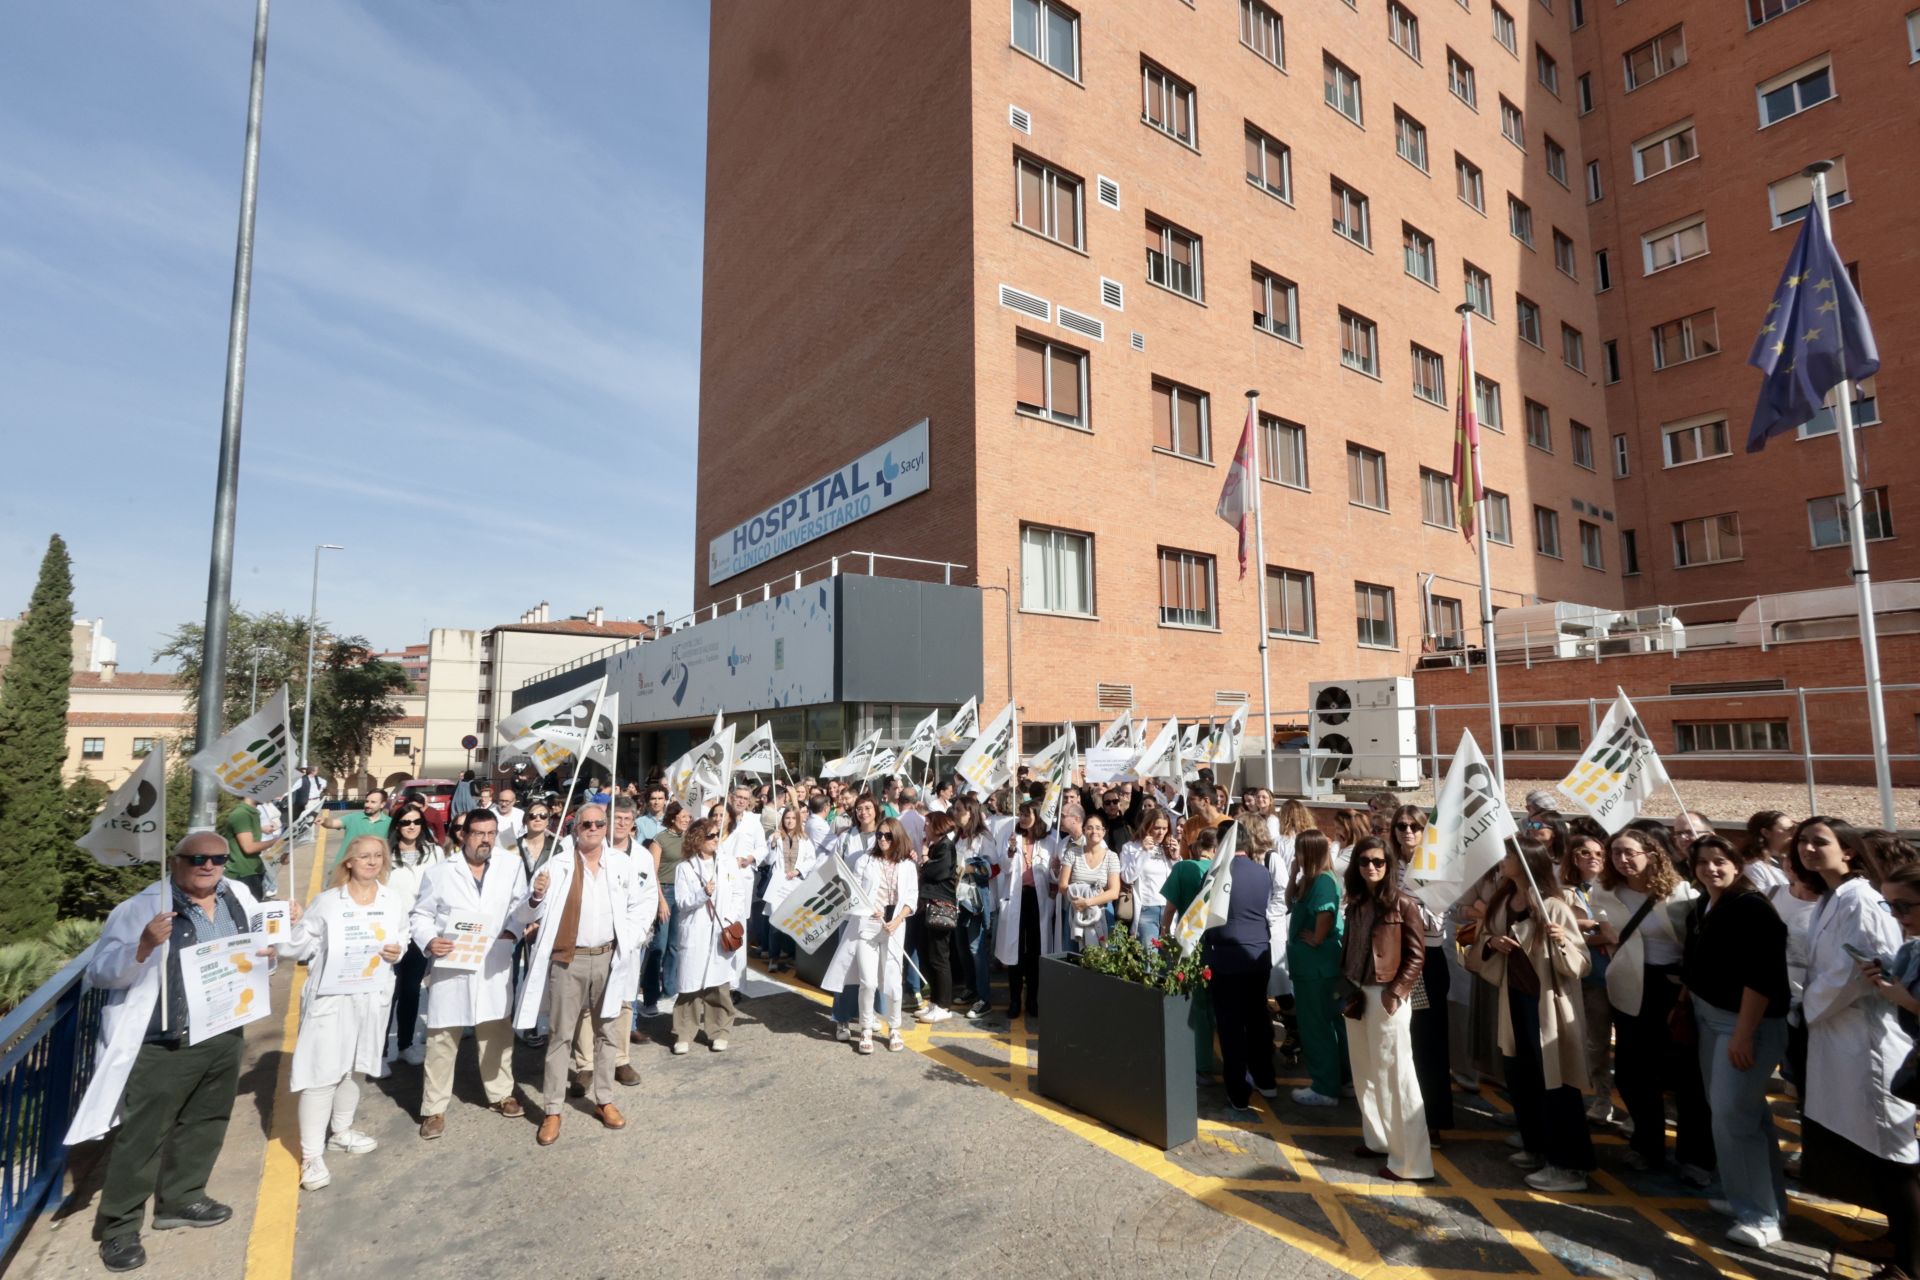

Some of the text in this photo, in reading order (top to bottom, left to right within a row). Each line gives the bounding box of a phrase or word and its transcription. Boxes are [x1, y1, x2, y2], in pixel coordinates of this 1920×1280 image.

[901, 452, 924, 474] Sacyl
[733, 463, 869, 554] HOSPITAL
[773, 494, 871, 554] UNIVERSITARIO
